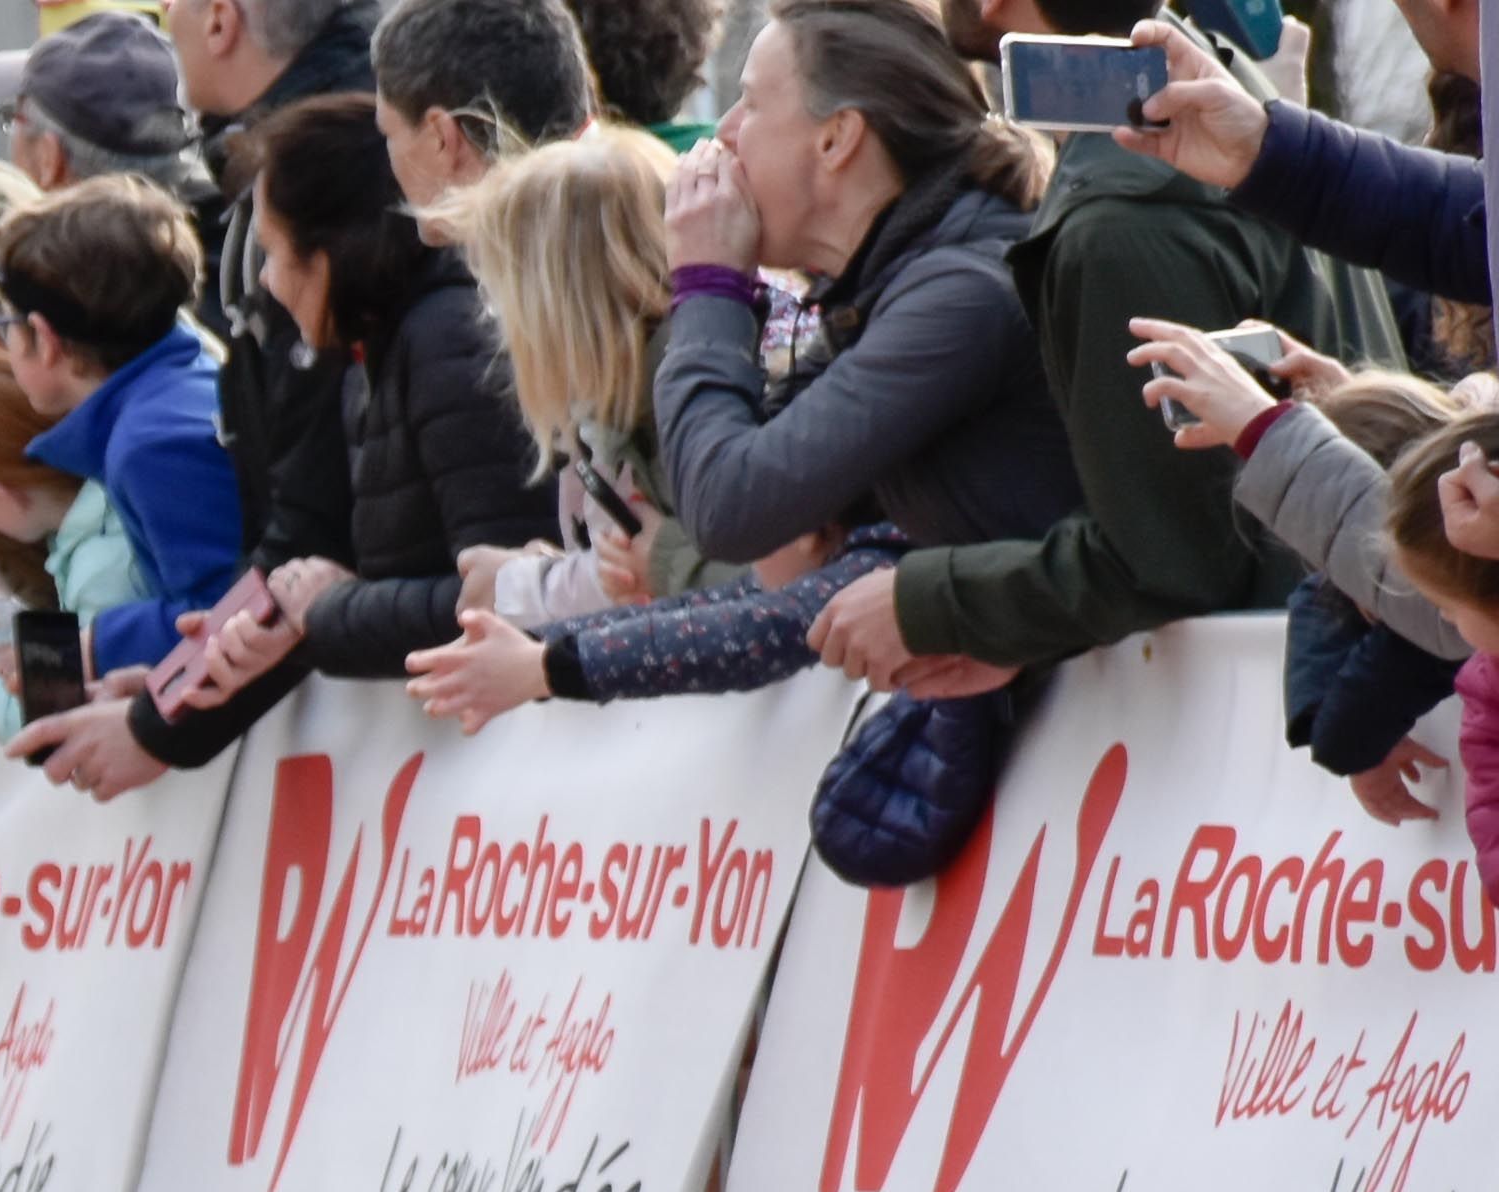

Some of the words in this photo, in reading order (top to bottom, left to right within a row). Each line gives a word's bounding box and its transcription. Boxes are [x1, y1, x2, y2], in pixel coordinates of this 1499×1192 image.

[455, 967, 517, 1085] Ville
[510, 992, 546, 1073] et
[528, 974, 614, 1156] Agglo
[1215, 998, 1316, 1128] Ville
[1312, 1028, 1367, 1120] et
